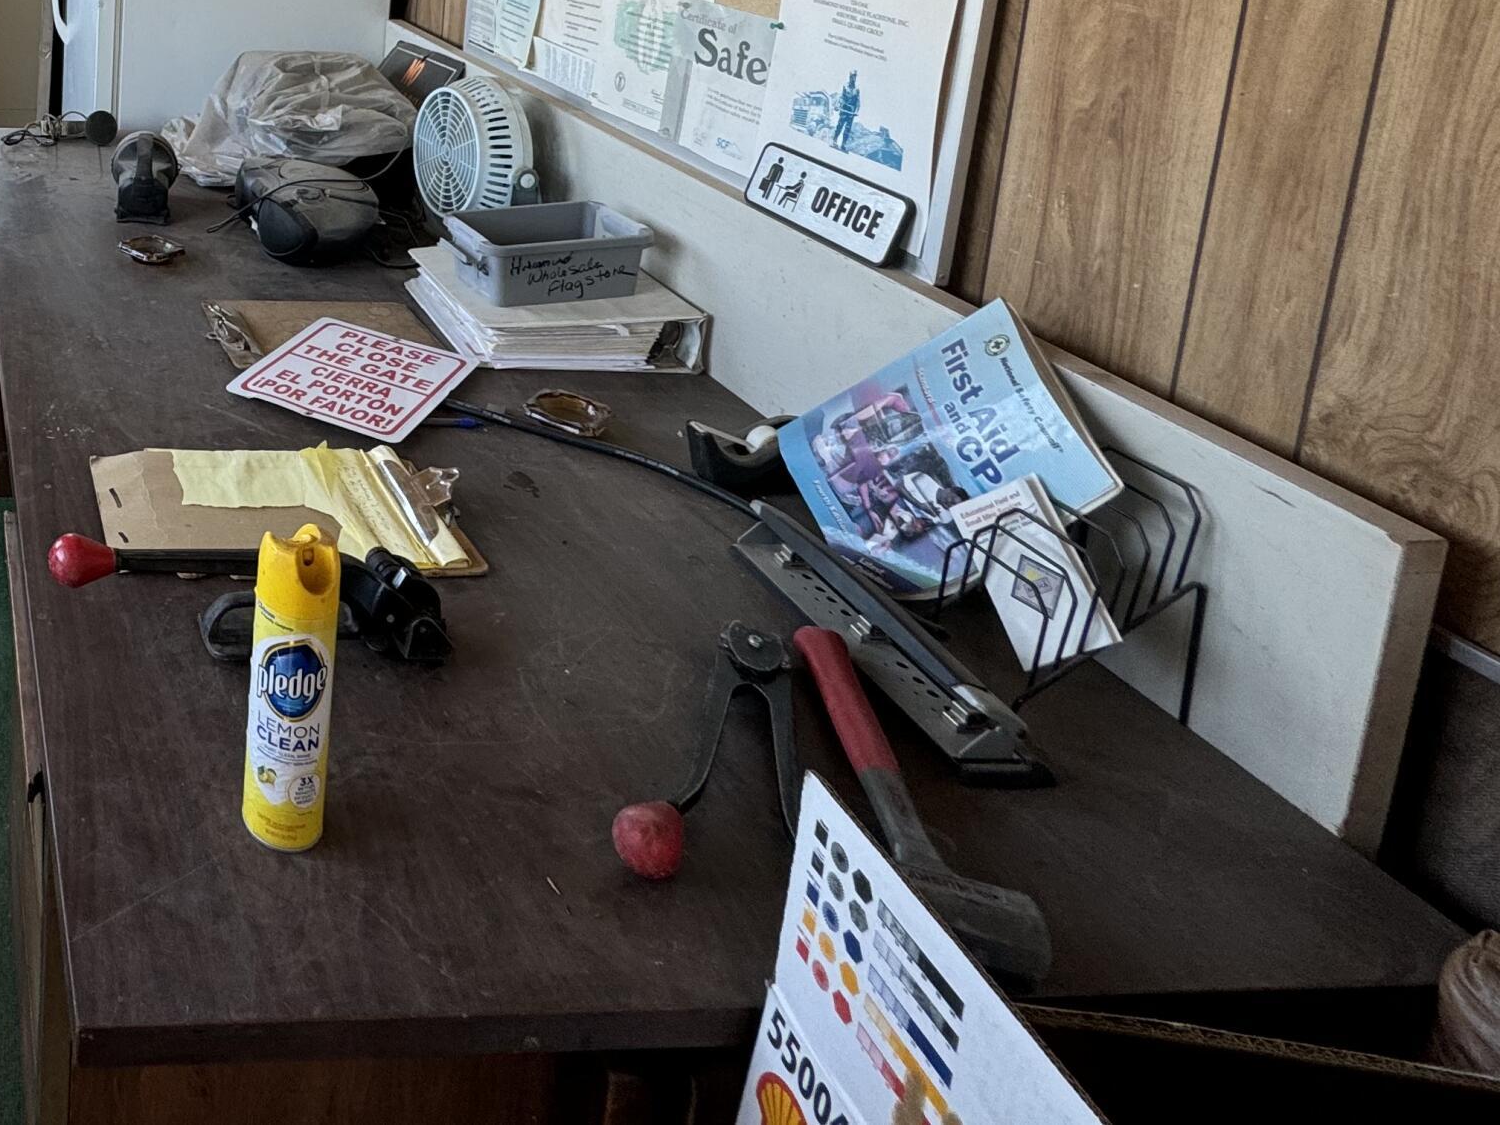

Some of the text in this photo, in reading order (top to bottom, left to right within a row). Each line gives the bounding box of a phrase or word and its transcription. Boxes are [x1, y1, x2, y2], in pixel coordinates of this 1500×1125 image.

[680, 9, 738, 35] Certificate of
[694, 27, 771, 86] Safe
[811, 186, 884, 240] OFFICE
[304, 344, 435, 391] THE GATE
[335, 342, 422, 374] CLOSE
[340, 330, 442, 366] PLEASE
[275, 369, 405, 417] EL PORTÓN
[310, 366, 393, 398] CIERRA
[941, 338, 1021, 464] First Aid
[1000, 356, 1021, 389] National
[1014, 386, 1036, 416] Safety
[308, 394, 395, 429] FAVOR!
[943, 401, 1003, 485] and CP
[256, 663, 327, 705] pledge
[257, 724, 319, 752] CLEAN
[258, 709, 320, 738] LEMON
[300, 776, 314, 787] 3X
